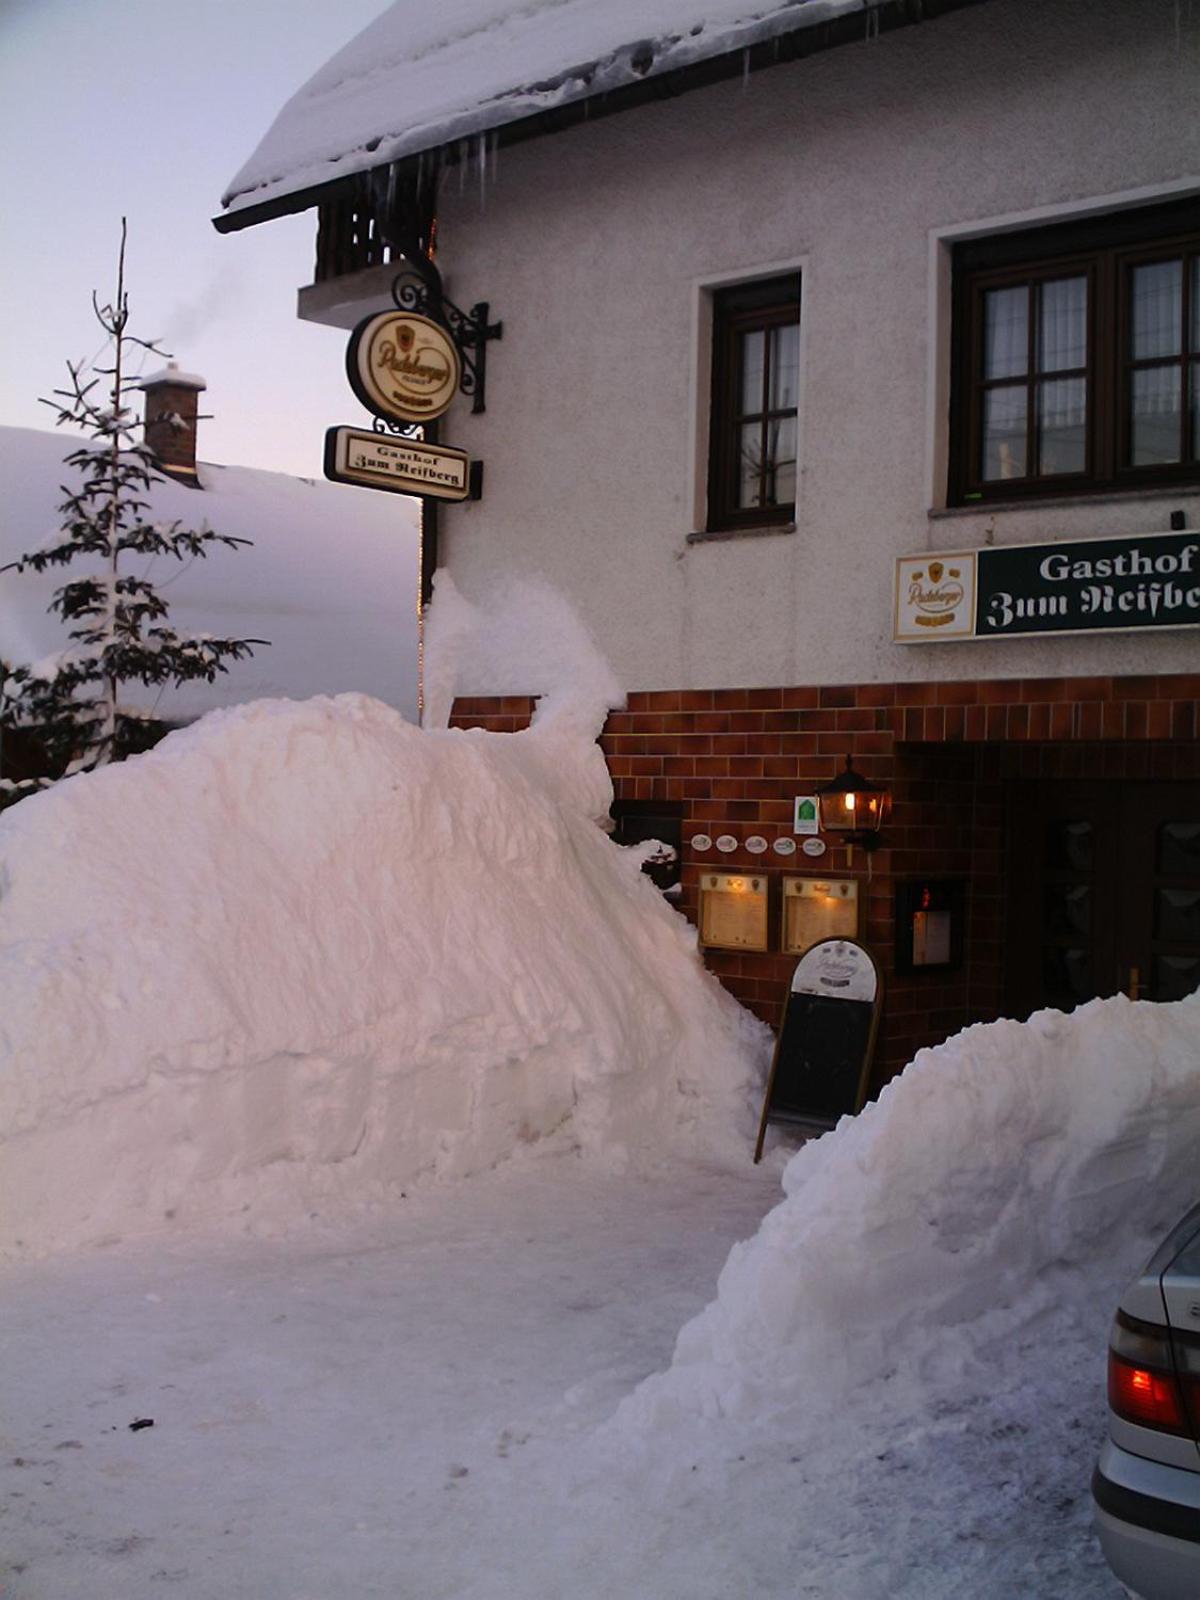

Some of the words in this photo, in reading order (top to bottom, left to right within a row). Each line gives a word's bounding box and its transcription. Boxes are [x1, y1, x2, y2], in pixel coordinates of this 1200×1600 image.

[355, 453, 389, 469] Zum
[377, 446, 439, 465] Gasthof
[1039, 545, 1199, 581] Gasthof
[986, 592, 1067, 628] Zum
